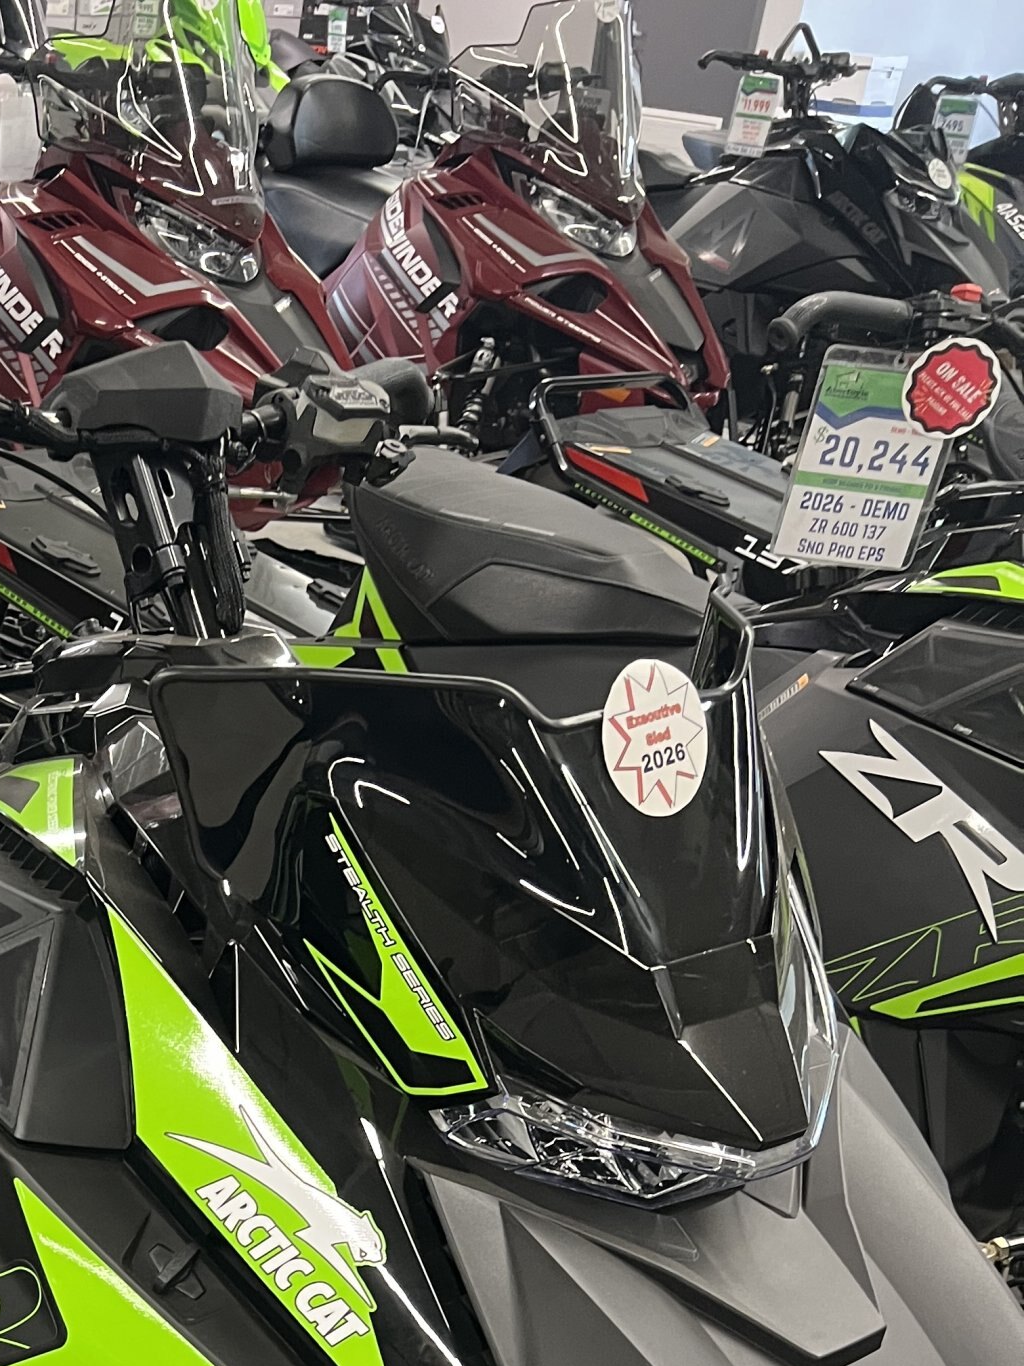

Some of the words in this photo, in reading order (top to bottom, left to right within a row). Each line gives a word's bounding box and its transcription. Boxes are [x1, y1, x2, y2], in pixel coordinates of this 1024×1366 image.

[384, 190, 460, 319] SIDEWINDER
[936, 361, 959, 383] ON
[952, 376, 982, 404] SALE
[800, 491, 844, 514] 2026
[860, 499, 910, 521] DEMO
[809, 517, 829, 534] ZR
[831, 521, 858, 538] 600
[863, 524, 887, 541] 137
[797, 538, 824, 555] SNO
[827, 542, 855, 560] PRO
[857, 546, 885, 562] EPS
[626, 703, 682, 730] Executive
[645, 726, 672, 746] Sled
[642, 742, 686, 774] 2026
[325, 833, 396, 947] STEALTH
[391, 952, 457, 1042] SERIES
[195, 1174, 316, 1292] ARCTIC
[294, 1280, 371, 1348] CAT
